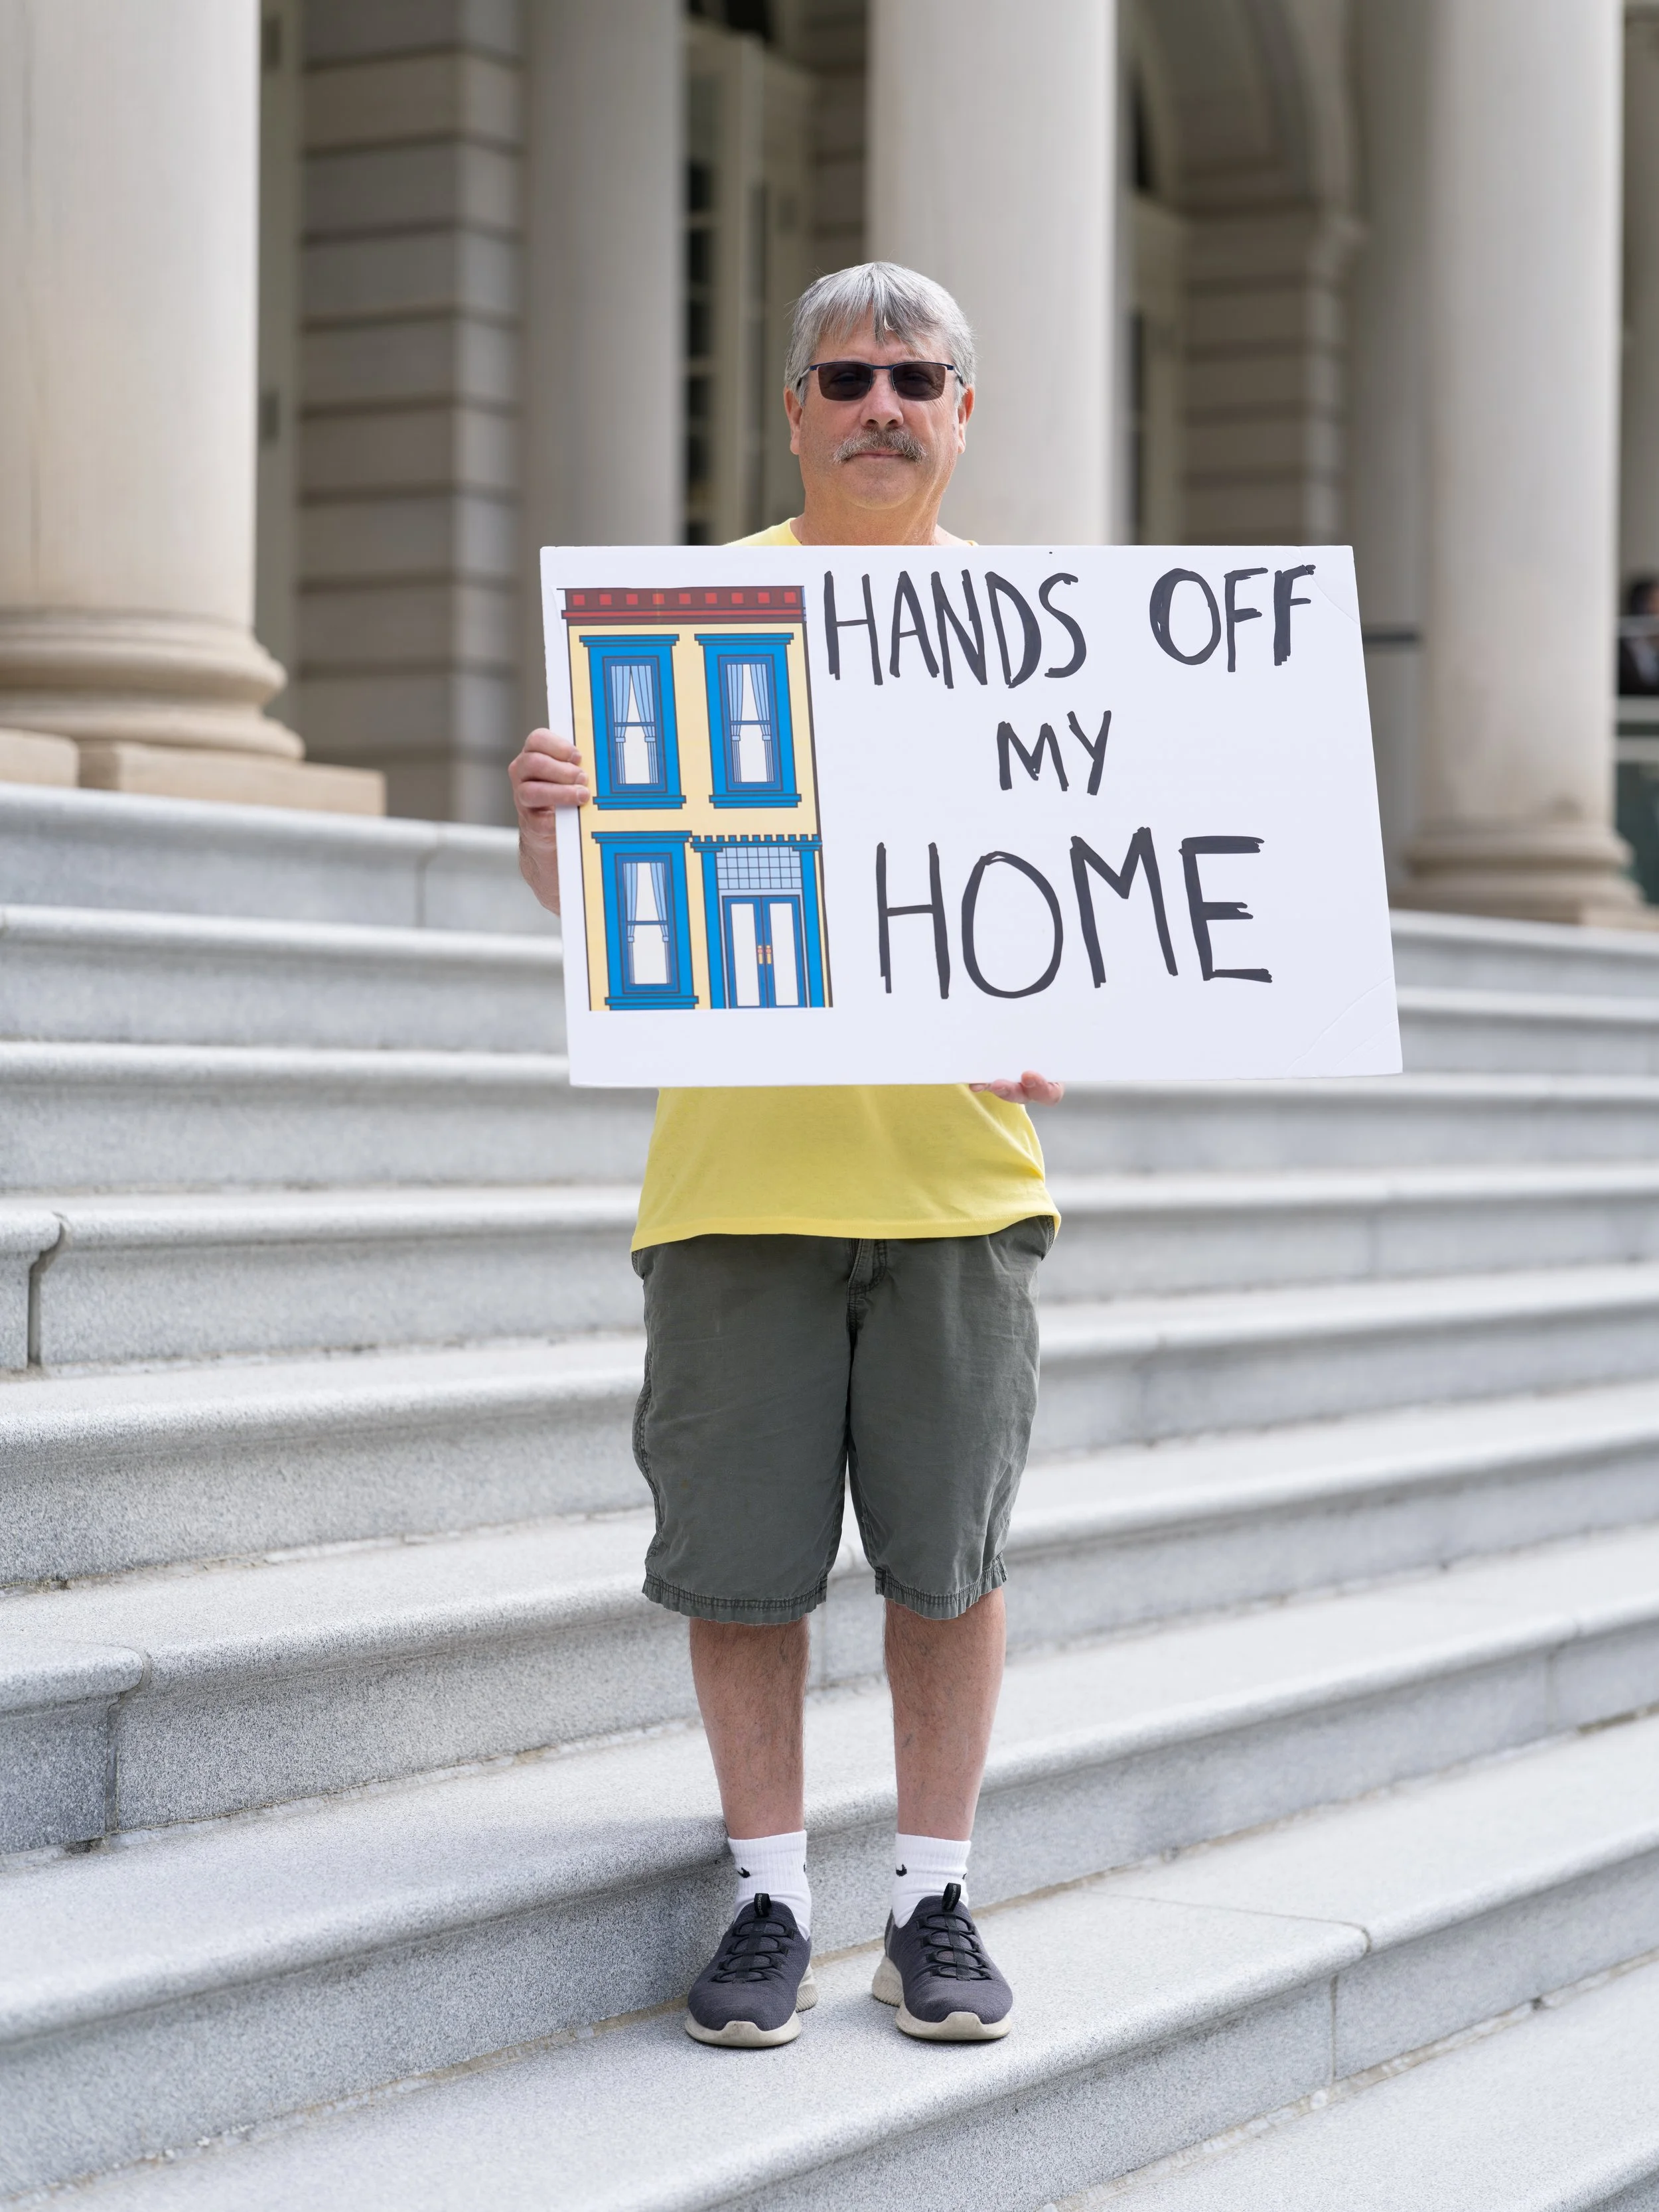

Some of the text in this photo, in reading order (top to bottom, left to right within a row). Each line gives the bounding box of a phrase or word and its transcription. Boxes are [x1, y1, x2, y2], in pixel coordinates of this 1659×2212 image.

[824, 565, 1315, 688] HANDS OFF
[997, 711, 1111, 795] MY
[877, 827, 1272, 998] HOME
